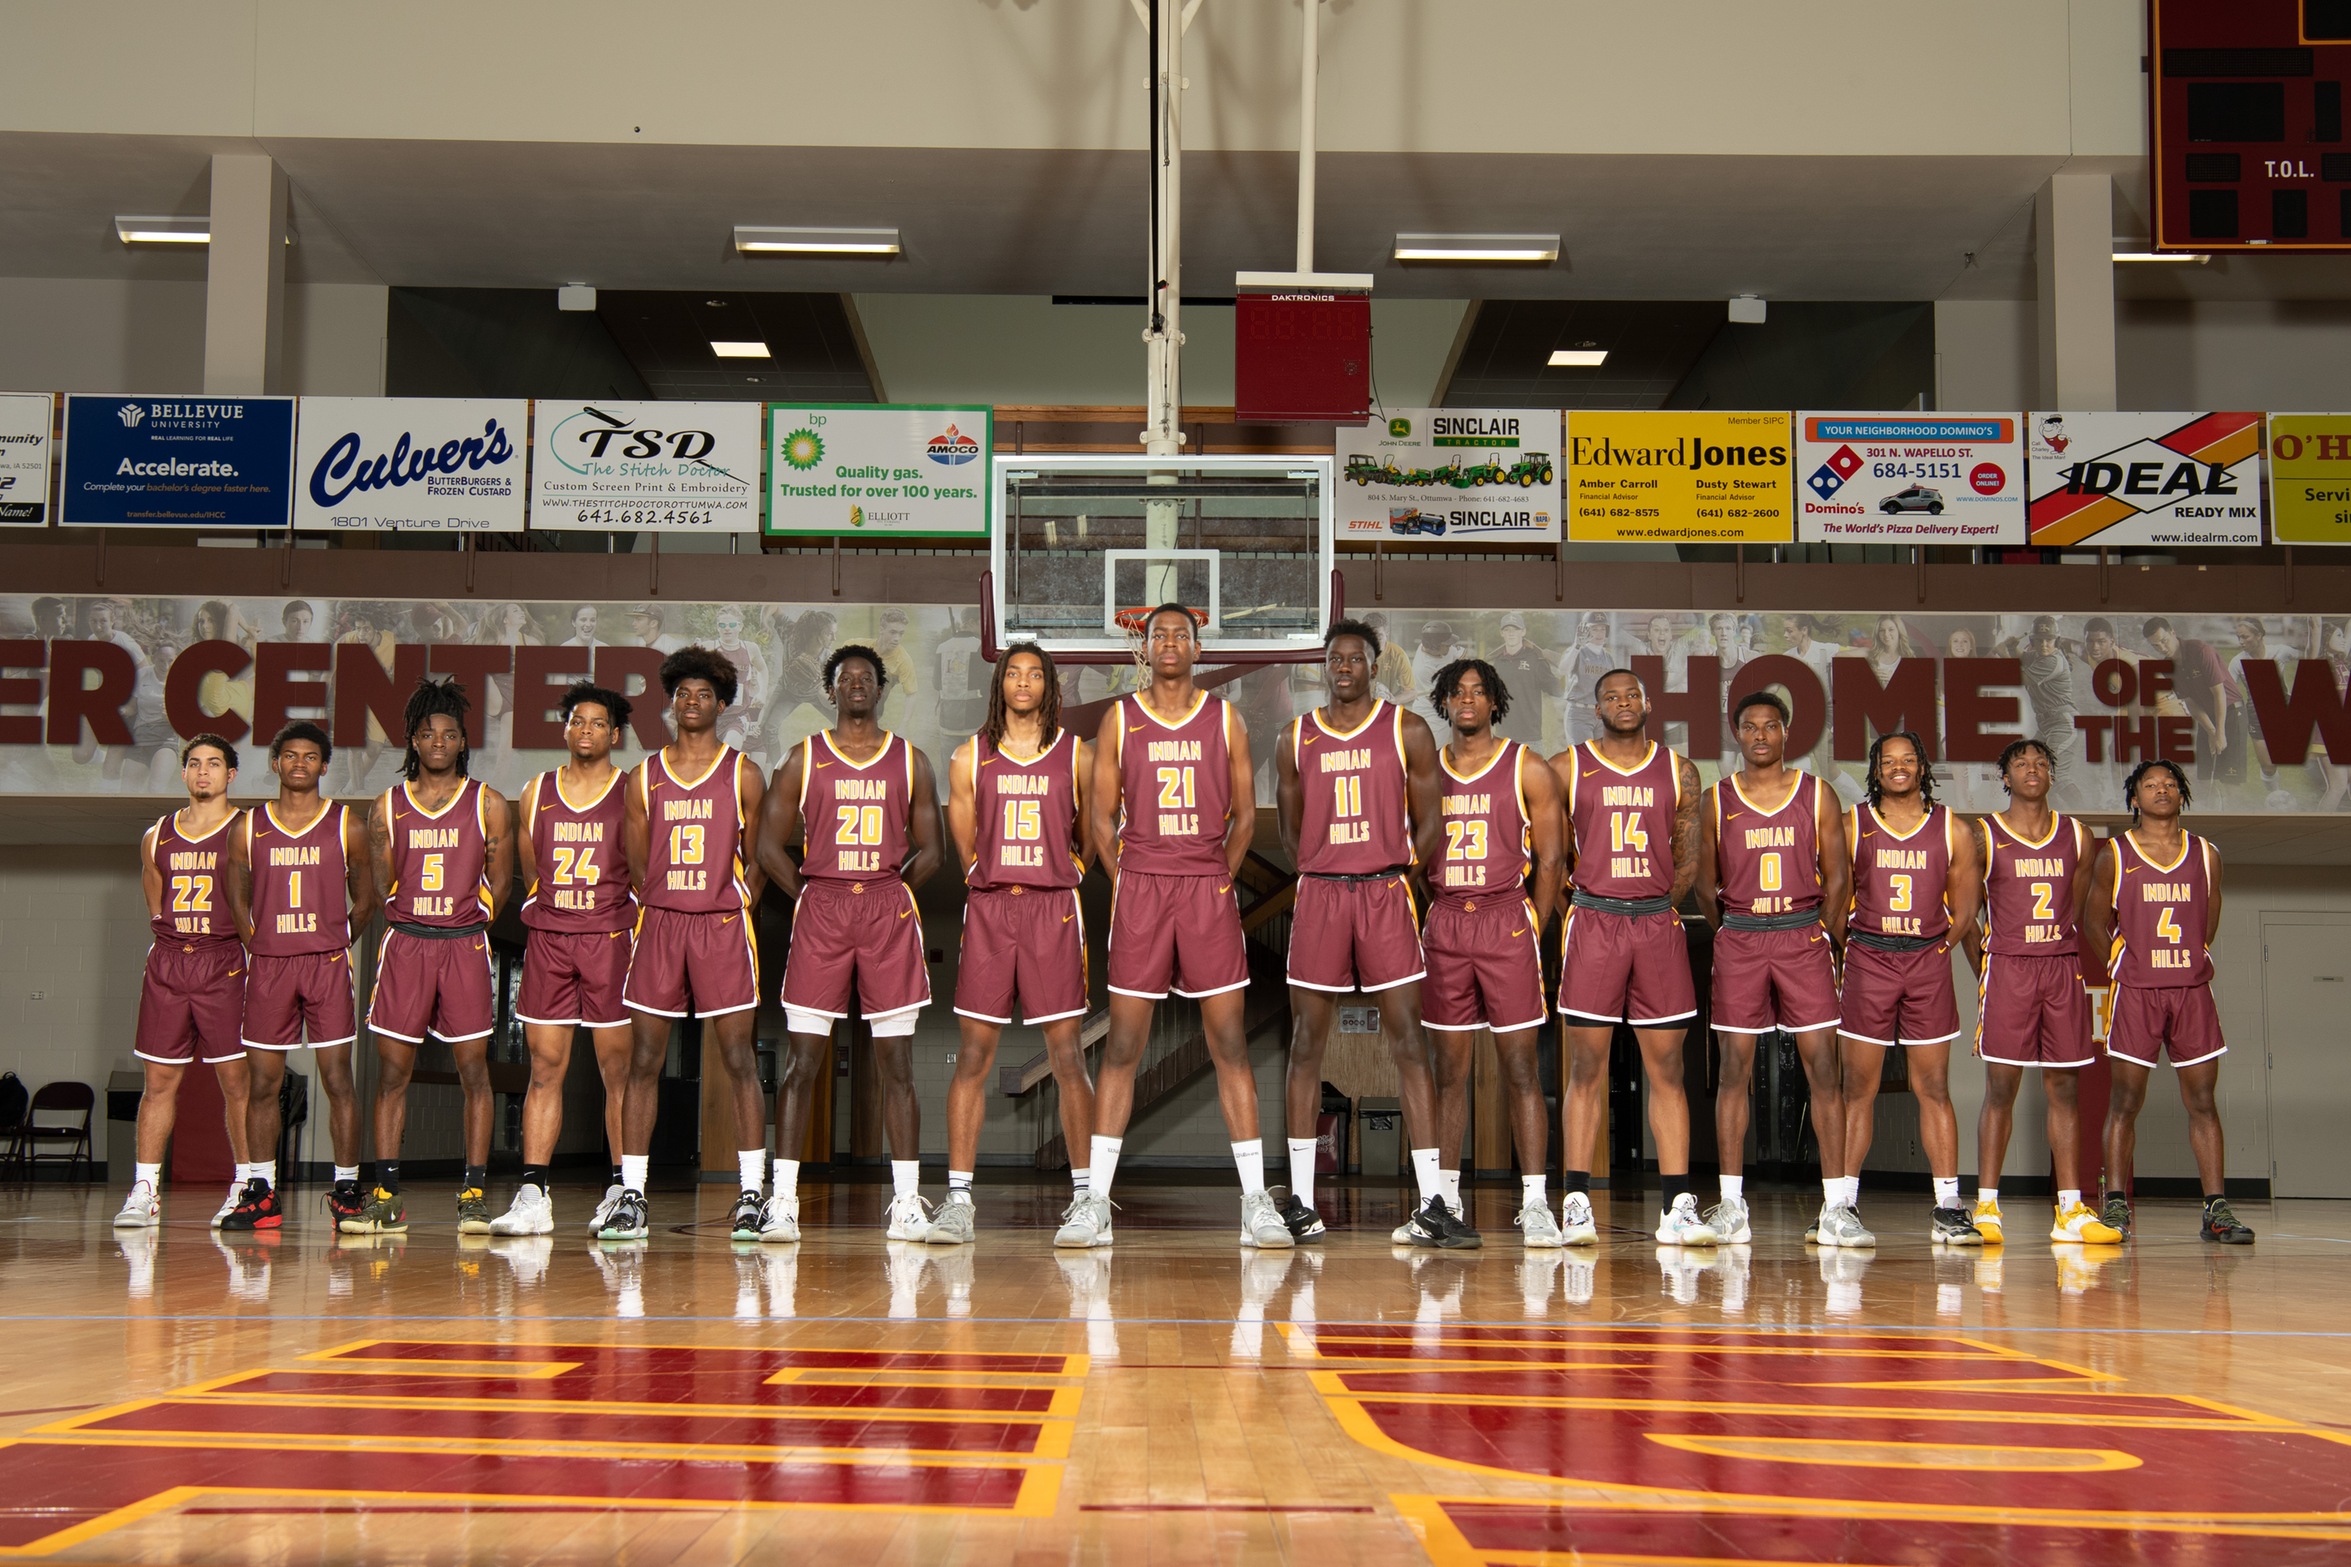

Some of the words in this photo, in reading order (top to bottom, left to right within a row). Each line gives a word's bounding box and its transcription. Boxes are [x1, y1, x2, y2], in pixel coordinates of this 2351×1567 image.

[2264, 160, 2314, 178] T.O.L.
[1272, 294, 1335, 302] DAKTRONICS
[151, 404, 243, 419] BELLEVUE
[809, 413, 827, 428] bp
[1728, 417, 1760, 425] Member
[1763, 417, 1785, 425] SIPC
[151, 421, 221, 429] UNIVERSITY
[1434, 418, 1520, 436] SINCLAIR
[1825, 426, 1852, 435] YOUR
[1855, 426, 1938, 436] NEIGHBORHOOD
[1940, 427, 1993, 436] DOMINO'S
[579, 429, 716, 460] TSD
[927, 445, 979, 454] AMOCO
[1571, 437, 1687, 466] Edward
[1690, 438, 1787, 470] Jones
[1867, 448, 1886, 458] 301
[1889, 448, 1901, 458] N.
[1904, 448, 1956, 458] WAPELLO
[1958, 448, 1973, 458] ST.
[22, 462, 42, 470] 52501
[116, 457, 239, 477] Accelerate.
[310, 418, 514, 508] Culver's
[582, 463, 614, 476] The
[620, 463, 672, 477] Stitch
[678, 464, 731, 478] Doctor
[836, 465, 890, 481] Quality
[893, 467, 923, 481] gas.
[1873, 463, 1962, 479] 684-5151
[84, 482, 125, 493] Complete
[126, 484, 145, 494] your
[191, 484, 221, 494] degree
[223, 484, 247, 493] faster
[249, 485, 271, 493] here.
[505, 478, 512, 486] &
[544, 481, 588, 492] Custom
[592, 481, 630, 492] Screen
[635, 482, 663, 492] Print
[668, 483, 676, 492] &
[681, 483, 748, 495] Embroidery
[1579, 479, 1616, 489] Amber
[1620, 480, 1658, 489] Carroll
[1696, 480, 1728, 491] Dusty
[1733, 480, 1777, 489] Stewart
[2066, 462, 2238, 496] IDEAL
[781, 484, 836, 497] Trusted
[841, 484, 862, 497] for
[866, 488, 899, 498] over
[902, 486, 929, 498] 100
[934, 487, 978, 500] years.
[1389, 495, 1408, 503] Mary
[543, 499, 748, 510] WWW.THESTITCHDOCTOROTTUMWA.COM
[1579, 508, 1606, 518] (641)
[1610, 509, 1660, 517] 682-8575
[1697, 509, 1723, 518] (641)
[1728, 509, 1780, 518] 682-2600
[1805, 502, 1865, 514] Domino's
[2175, 507, 2225, 518] READY
[2229, 507, 2256, 518] MIX
[127, 511, 226, 519] transfer.bellevue.edu/IHCC
[330, 516, 368, 527] 1801
[375, 517, 440, 528] Venture
[448, 517, 490, 529] Drive
[577, 510, 712, 524] 641.682.4561
[868, 512, 910, 521] ELLIOTT
[1348, 521, 1383, 529] STIHL
[1450, 511, 1530, 527] SINCLAIR
[1617, 528, 1744, 538] www.edwardjones.com
[1824, 523, 1842, 533] The
[1845, 524, 1884, 534] World's
[1886, 524, 1912, 534] Pizza
[1915, 524, 1958, 536] Delivery
[1961, 525, 1999, 536] Expert!
[2151, 532, 2258, 543] www.idealrm.com
[2092, 658, 2175, 707] OF
[164, 640, 668, 749] CENTER
[1630, 654, 2022, 763] HOME
[2241, 659, 2351, 765] W
[2074, 715, 2196, 764] THE
[1148, 740, 1202, 762] INDIAN
[1321, 748, 1371, 774] INDIAN
[835, 779, 886, 801] INDIAN
[997, 774, 1049, 796] INDIAN
[1157, 767, 1196, 809] 21
[1334, 775, 1362, 818] 11
[1442, 793, 1490, 817] INDIAN
[1603, 786, 1654, 808] INDIAN
[664, 799, 713, 822] INDIAN
[1004, 800, 1041, 841] 15
[554, 822, 603, 842] INDIAN
[836, 805, 883, 846] 20
[1158, 814, 1199, 837] HILLS
[1330, 820, 1370, 845] HILLS
[1610, 811, 1648, 853] 14
[409, 828, 459, 849] INDIAN
[670, 825, 705, 865] 13
[1445, 820, 1488, 861] 23
[1745, 827, 1795, 850] INDIAN
[170, 851, 217, 871] INDIAN
[270, 846, 320, 867] INDIAN
[552, 847, 600, 885] 24
[838, 850, 880, 872] HILLS
[1001, 846, 1044, 867] HILLS
[1877, 849, 1927, 870] INDIAN
[421, 854, 444, 891] 5
[1445, 865, 1486, 887] HILLS
[1611, 857, 1651, 879] HILLS
[1759, 852, 1783, 892] 0
[2015, 858, 2064, 878] INDIAN
[288, 871, 301, 908] 1
[667, 870, 707, 891] HILLS
[172, 875, 213, 912] 22
[554, 890, 595, 910] HILLS
[1889, 874, 1913, 912] 3
[2031, 883, 2055, 920] 2
[2143, 883, 2191, 902] INDIAN
[413, 896, 453, 916] HILLS
[174, 917, 211, 935] HILLS
[276, 913, 317, 934] HILLS
[1882, 916, 1922, 936] HILLS
[2156, 908, 2181, 944] 4
[2025, 924, 2063, 944] HILLS
[2151, 949, 2191, 968] HILLS
